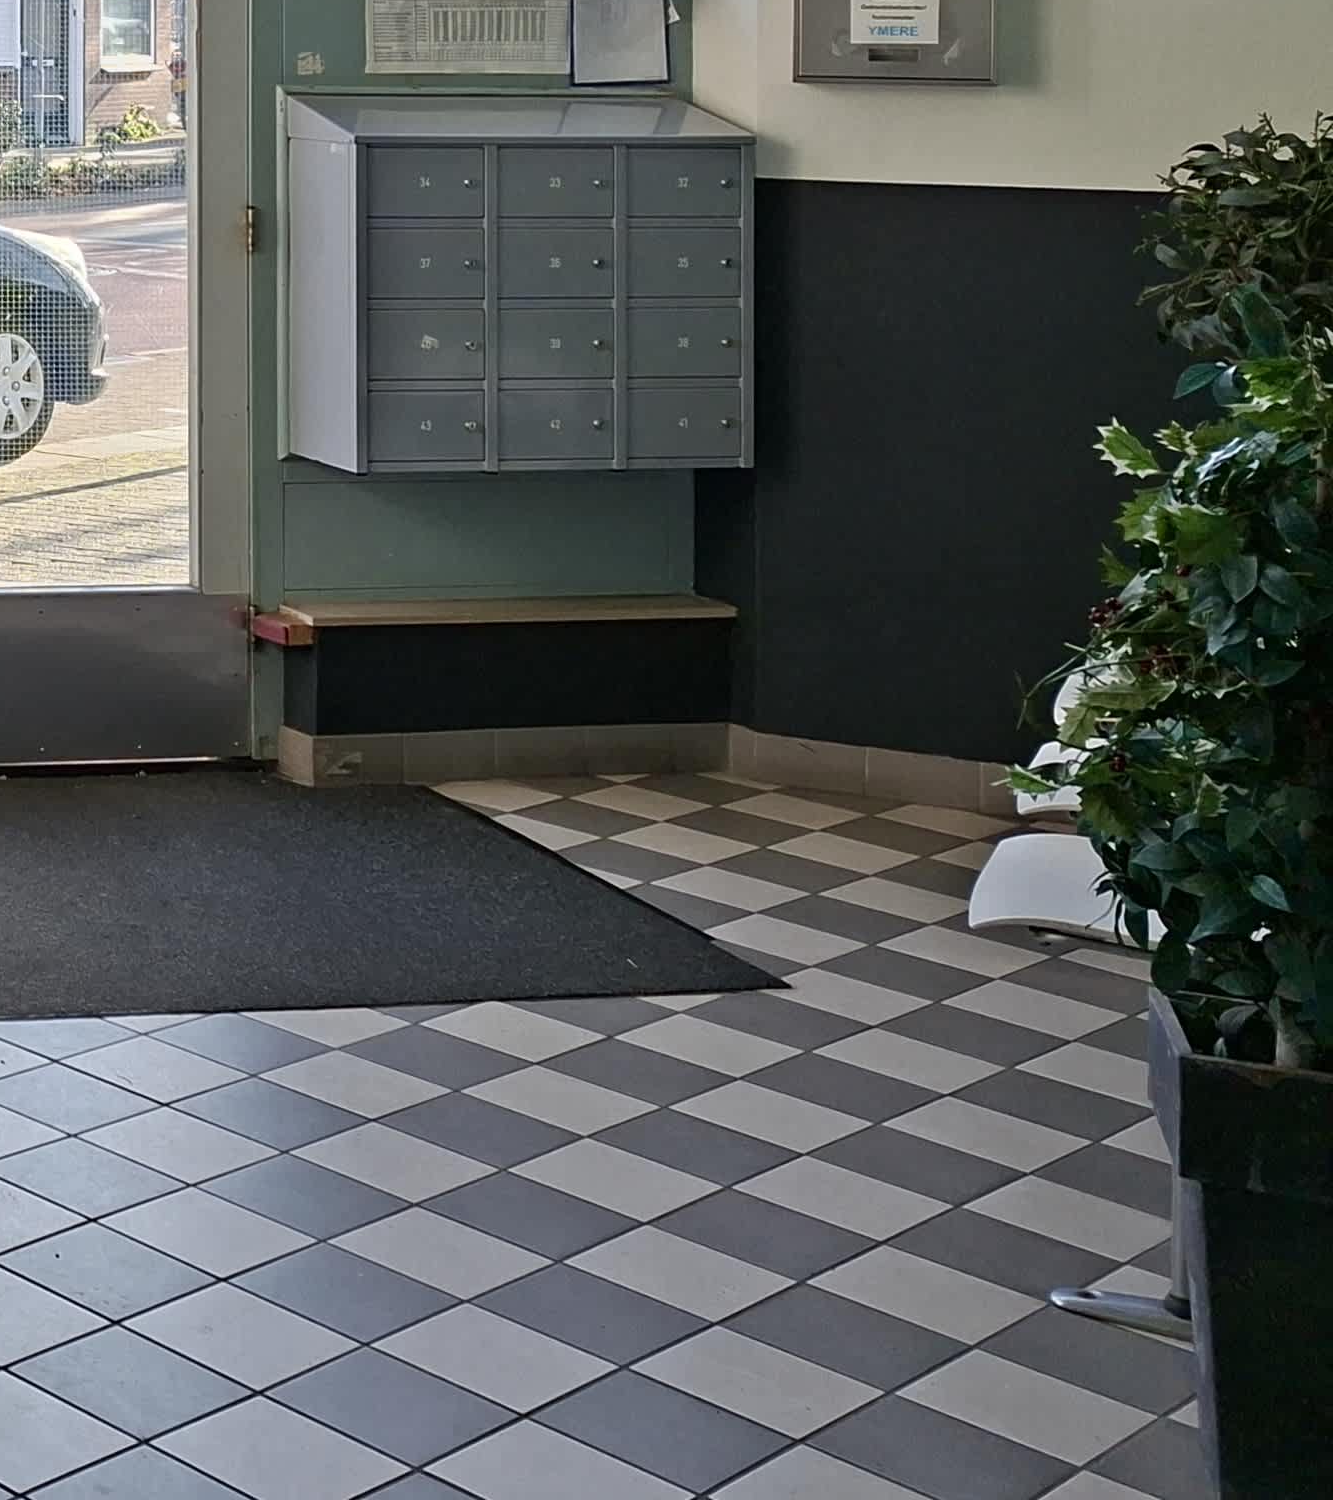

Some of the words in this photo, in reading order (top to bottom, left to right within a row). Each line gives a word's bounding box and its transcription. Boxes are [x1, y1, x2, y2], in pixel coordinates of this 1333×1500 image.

[869, 26, 918, 36] YMERE
[420, 177, 430, 188] 34
[677, 177, 689, 188] 32
[420, 257, 431, 269] 37
[678, 417, 688, 428] 41
